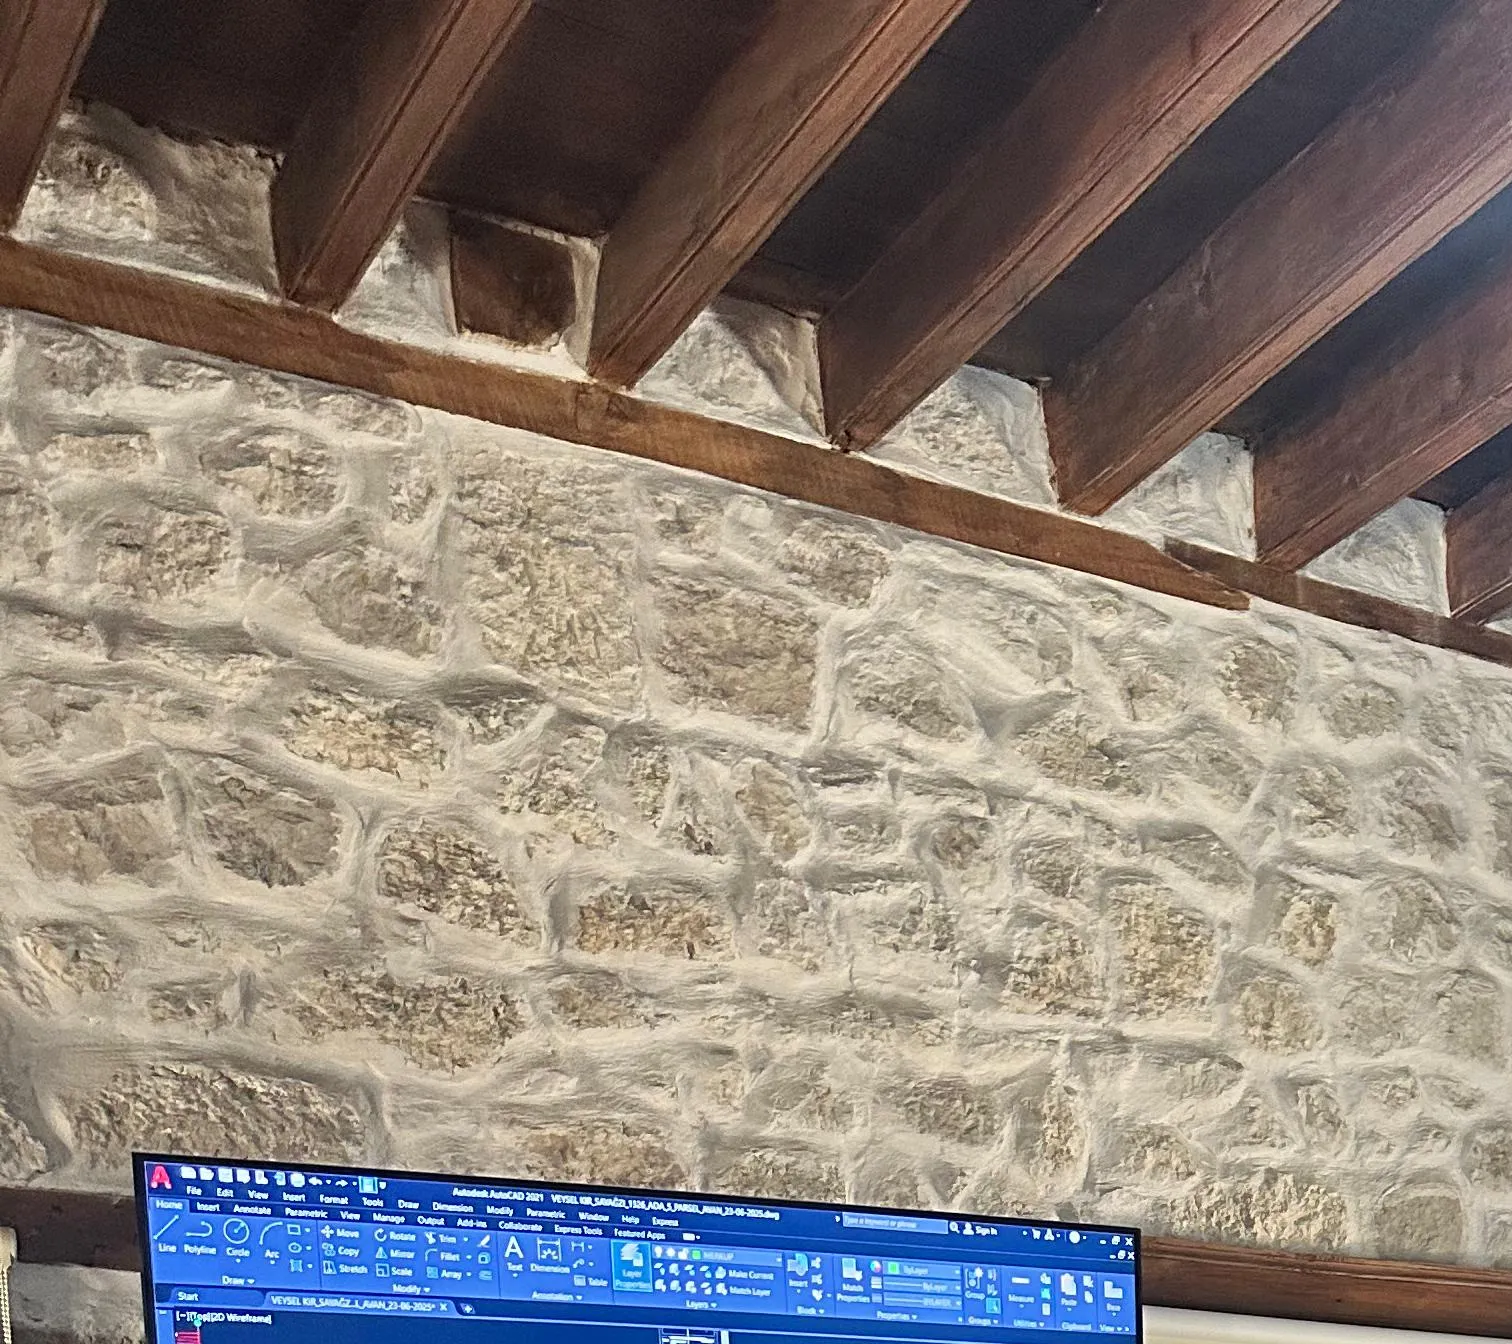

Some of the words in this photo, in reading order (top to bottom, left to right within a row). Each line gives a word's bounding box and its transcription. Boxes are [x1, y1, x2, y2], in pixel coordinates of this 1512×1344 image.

[489, 1190, 525, 1201] AutoCAD
[187, 1186, 202, 1196] File
[217, 1188, 234, 1198] Edit
[248, 1190, 268, 1200] View
[283, 1192, 306, 1202] Insert
[320, 1194, 349, 1205] Format
[362, 1198, 384, 1208] Tools
[398, 1200, 419, 1210] Draw
[433, 1202, 474, 1213] Dimension
[487, 1206, 514, 1217] Modify
[527, 1208, 566, 1220] Parametric
[579, 1211, 610, 1222] Window
[622, 1215, 640, 1225] Help
[652, 1216, 679, 1227] Express
[156, 1200, 183, 1210] Home
[197, 1202, 220, 1212] Insert
[233, 1204, 272, 1215] Annotate
[285, 1207, 328, 1219] Parametric
[340, 1211, 360, 1220] View
[373, 1213, 405, 1224] Manage
[417, 1216, 445, 1226] Output
[457, 1218, 487, 1229] Add-ins
[498, 1221, 543, 1232] Collaborate
[555, 1224, 582, 1236] Express
[583, 1226, 603, 1236] Tools
[614, 1228, 645, 1239] Featured
[647, 1230, 666, 1241] Apps
[337, 1228, 359, 1238] Move
[390, 1232, 416, 1241] Rotate
[439, 1234, 456, 1243] Trim
[158, 1243, 177, 1253] Line
[184, 1244, 217, 1256] Polyline
[226, 1247, 250, 1257] Circle
[338, 1247, 360, 1257] Copy
[265, 1250, 279, 1259] Arc
[390, 1250, 415, 1259] Mirror
[440, 1252, 460, 1261] Fillet
[339, 1264, 368, 1274] Stretch
[391, 1267, 413, 1276] Scale
[507, 1262, 523, 1272] Text
[530, 1263, 570, 1274] Dimension
[222, 1275, 244, 1285] Draw
[441, 1270, 462, 1280] Array
[588, 1277, 608, 1287] Table
[393, 1283, 421, 1294] Modify
[177, 1291, 199, 1302] Start
[686, 1300, 709, 1310] Layers
